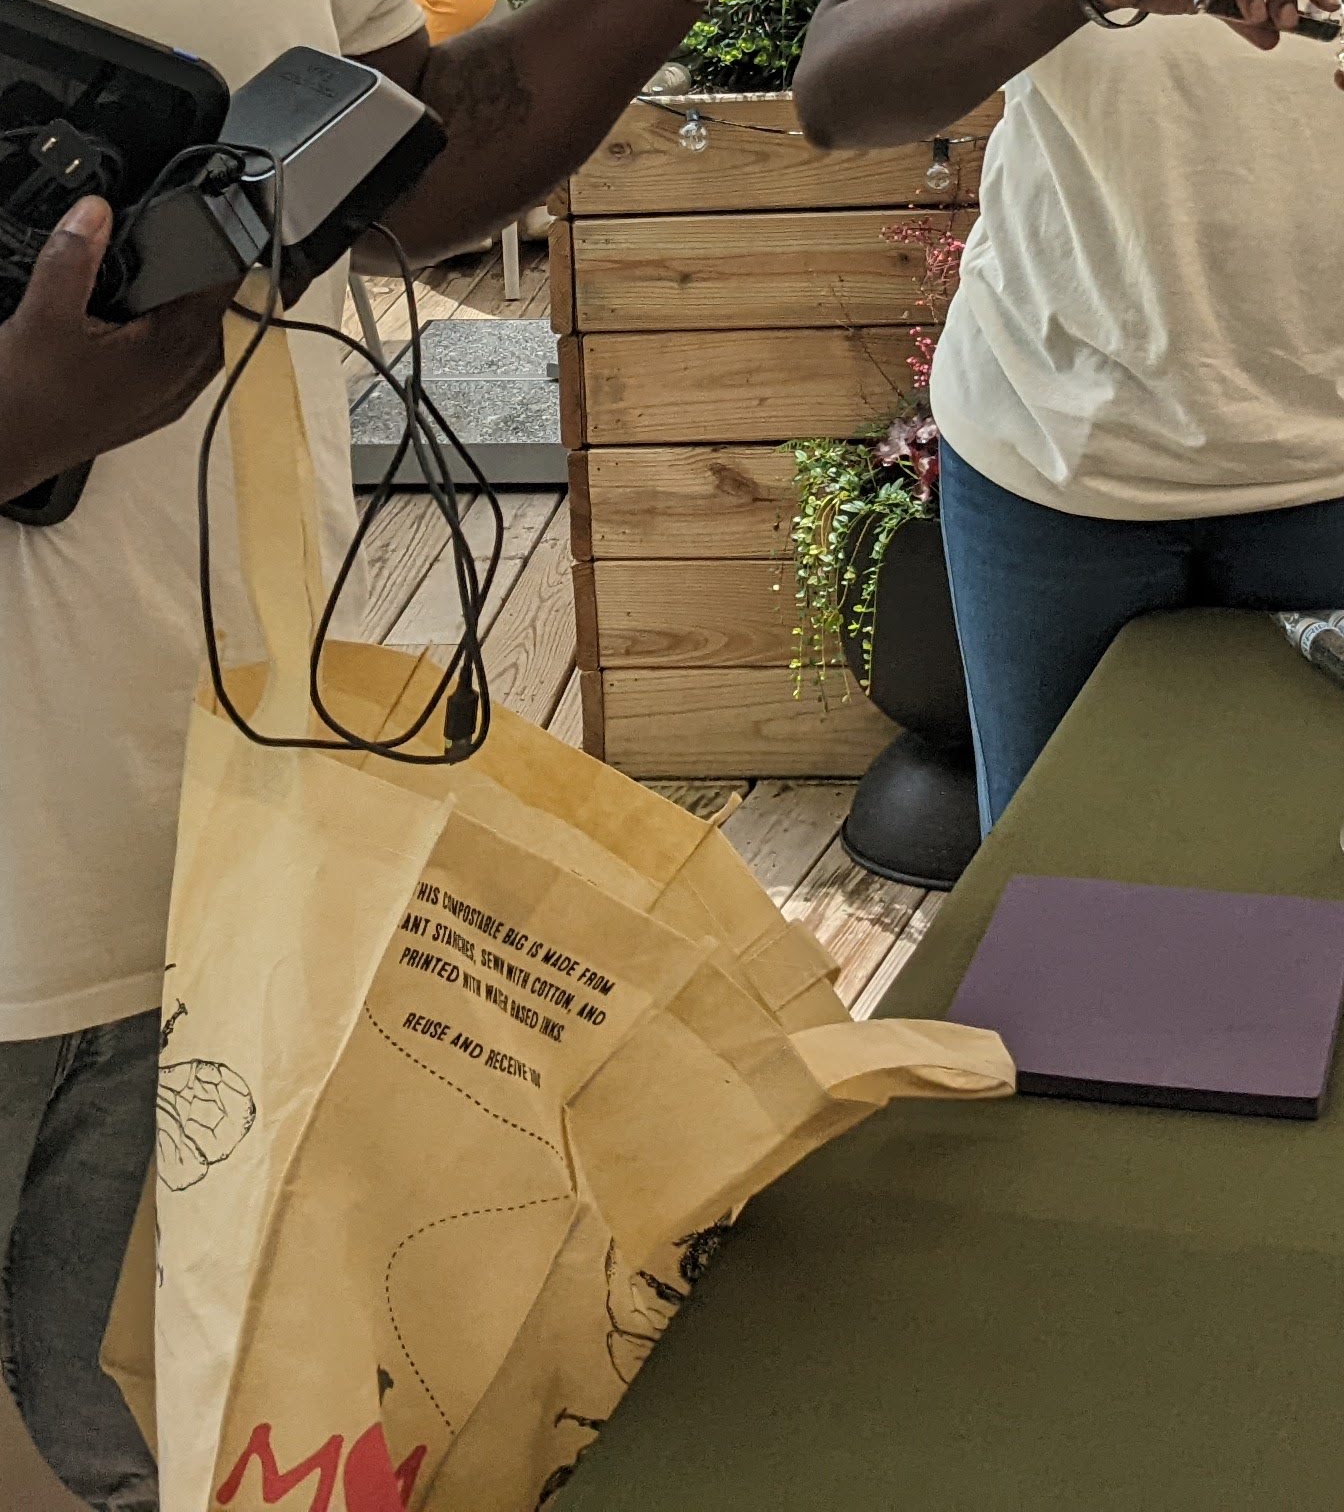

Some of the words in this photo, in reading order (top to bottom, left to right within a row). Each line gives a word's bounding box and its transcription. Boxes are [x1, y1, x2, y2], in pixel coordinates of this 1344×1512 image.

[416, 881, 440, 906] HIS
[502, 927, 529, 951] BAG
[526, 941, 544, 958] IS
[540, 947, 580, 977] MADE
[576, 967, 616, 996] FROM
[399, 947, 460, 983] PRINTED
[510, 999, 539, 1029] BASED
[506, 962, 531, 990] WITH
[530, 976, 575, 1014] COTTON,
[576, 1002, 607, 1026] AND
[402, 1012, 451, 1041] REUSE
[450, 1032, 484, 1059] AND
[484, 1048, 528, 1081] RECEIVE
